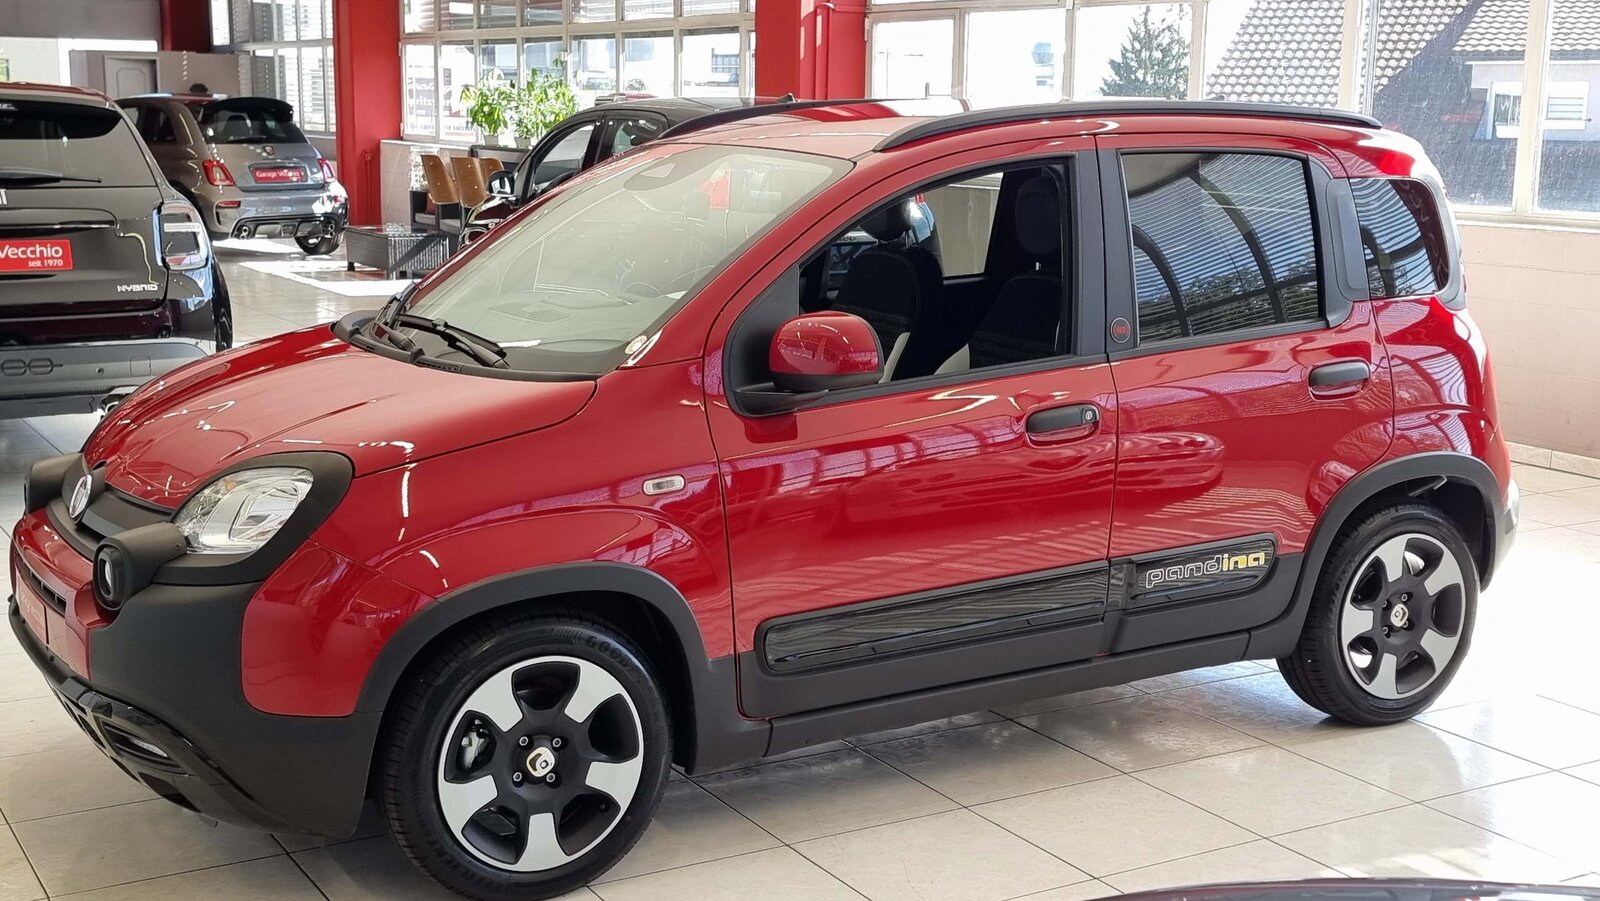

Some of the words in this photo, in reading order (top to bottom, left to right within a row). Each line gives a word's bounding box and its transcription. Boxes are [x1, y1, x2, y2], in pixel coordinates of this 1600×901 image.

[255, 171, 277, 179] Garage
[0, 243, 63, 259] Vecchio
[44, 259, 64, 267] 1970
[116, 284, 159, 292] HYBRID
[1146, 552, 1266, 588] pandina
